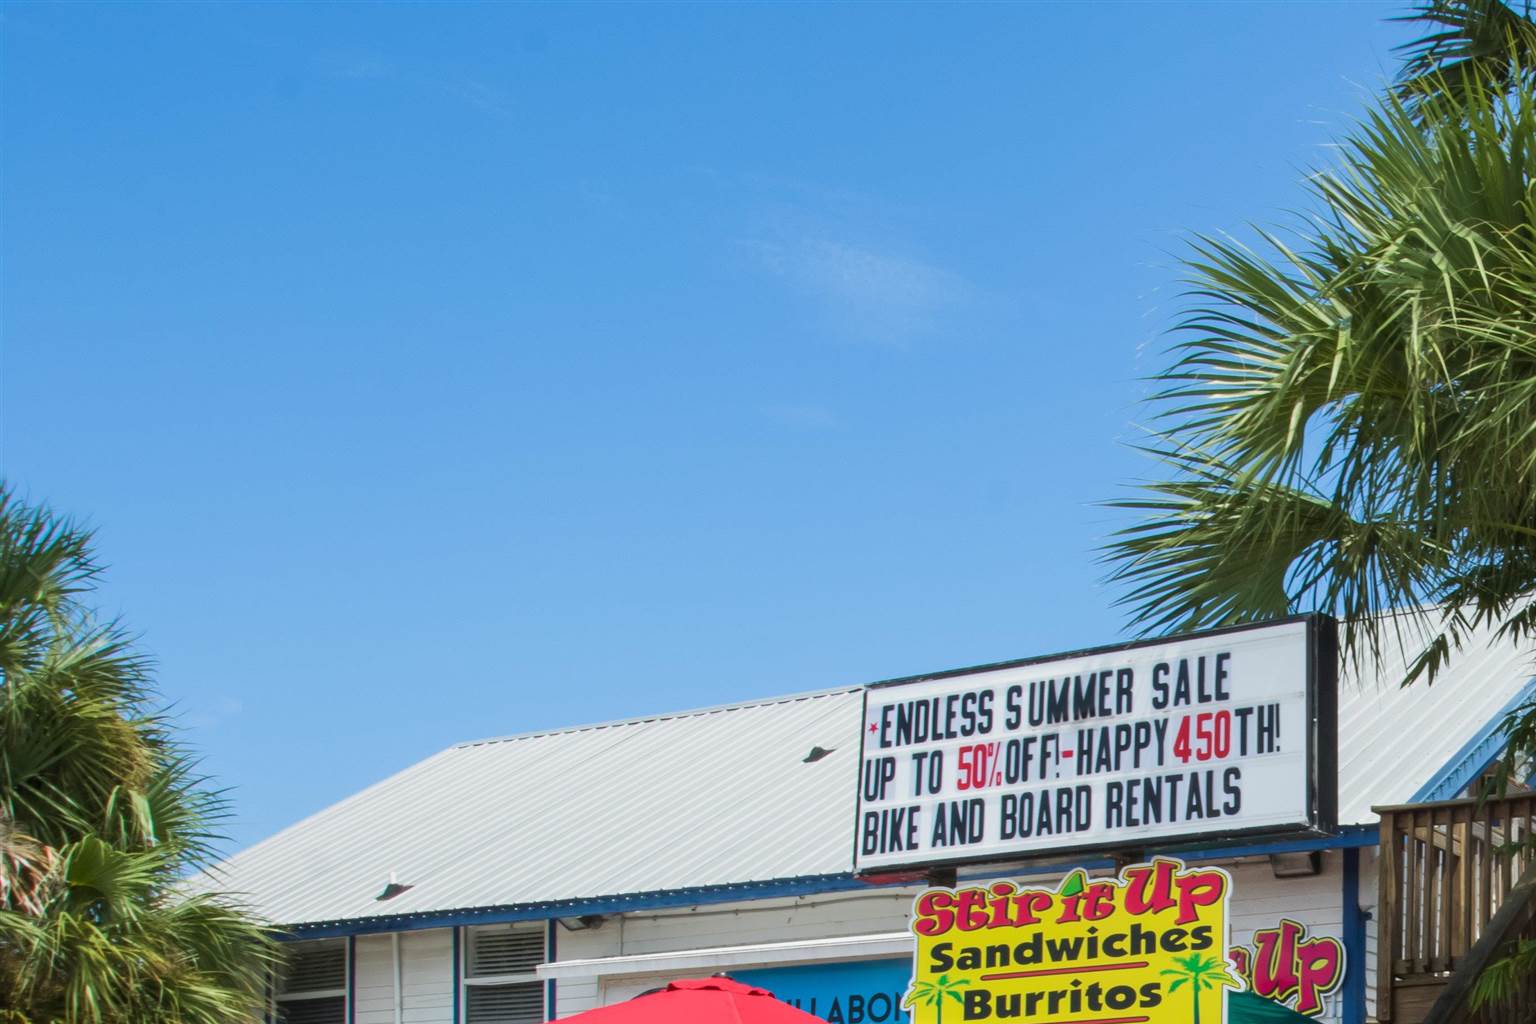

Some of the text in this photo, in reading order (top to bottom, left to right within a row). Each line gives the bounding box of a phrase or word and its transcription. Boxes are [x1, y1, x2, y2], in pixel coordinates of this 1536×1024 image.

[881, 652, 1231, 748] ENDLESS SUMMER SALE
[864, 755, 896, 802] UP
[912, 750, 943, 797] TO
[956, 741, 1002, 790] 50%
[1172, 704, 1281, 763] 450TH!
[862, 768, 1241, 856] BIKE AND BOARD RENTALS
[914, 860, 1226, 937] Stir it Up
[931, 923, 1213, 974] Sandwiches
[1252, 919, 1341, 1015] Up
[963, 977, 1162, 1022] Burritos
